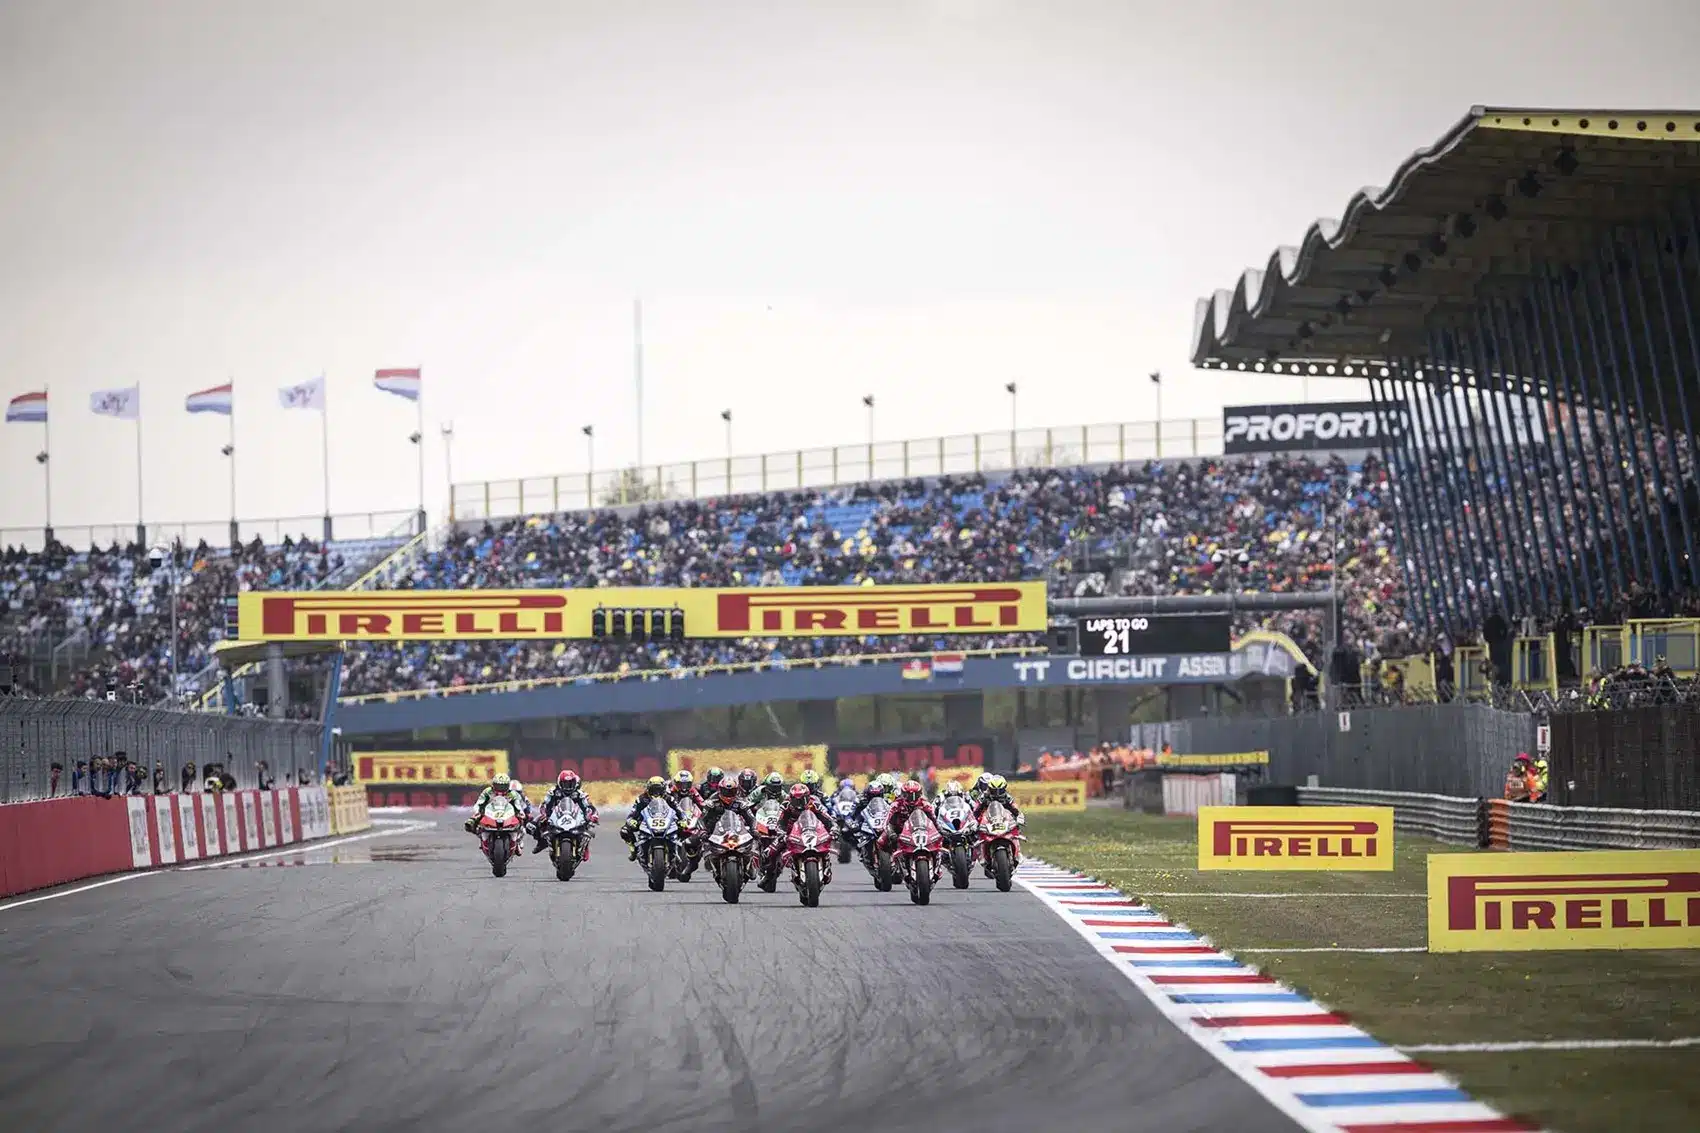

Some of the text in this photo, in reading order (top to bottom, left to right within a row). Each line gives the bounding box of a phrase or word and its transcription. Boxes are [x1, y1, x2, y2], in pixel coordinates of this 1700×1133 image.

[262, 594, 568, 635] PIRELLI
[717, 588, 1022, 631] PIRELLI
[1086, 617, 1149, 632] LAPS TO GO
[1103, 628, 1130, 654] 21
[1013, 660, 1050, 681] TT
[1067, 657, 1168, 680] CIRCUIT
[651, 818, 666, 828] 55
[805, 834, 816, 845] 7
[915, 834, 926, 844] 11
[1213, 820, 1380, 857] PIRELLI
[1448, 872, 1700, 931] PIRELLI
